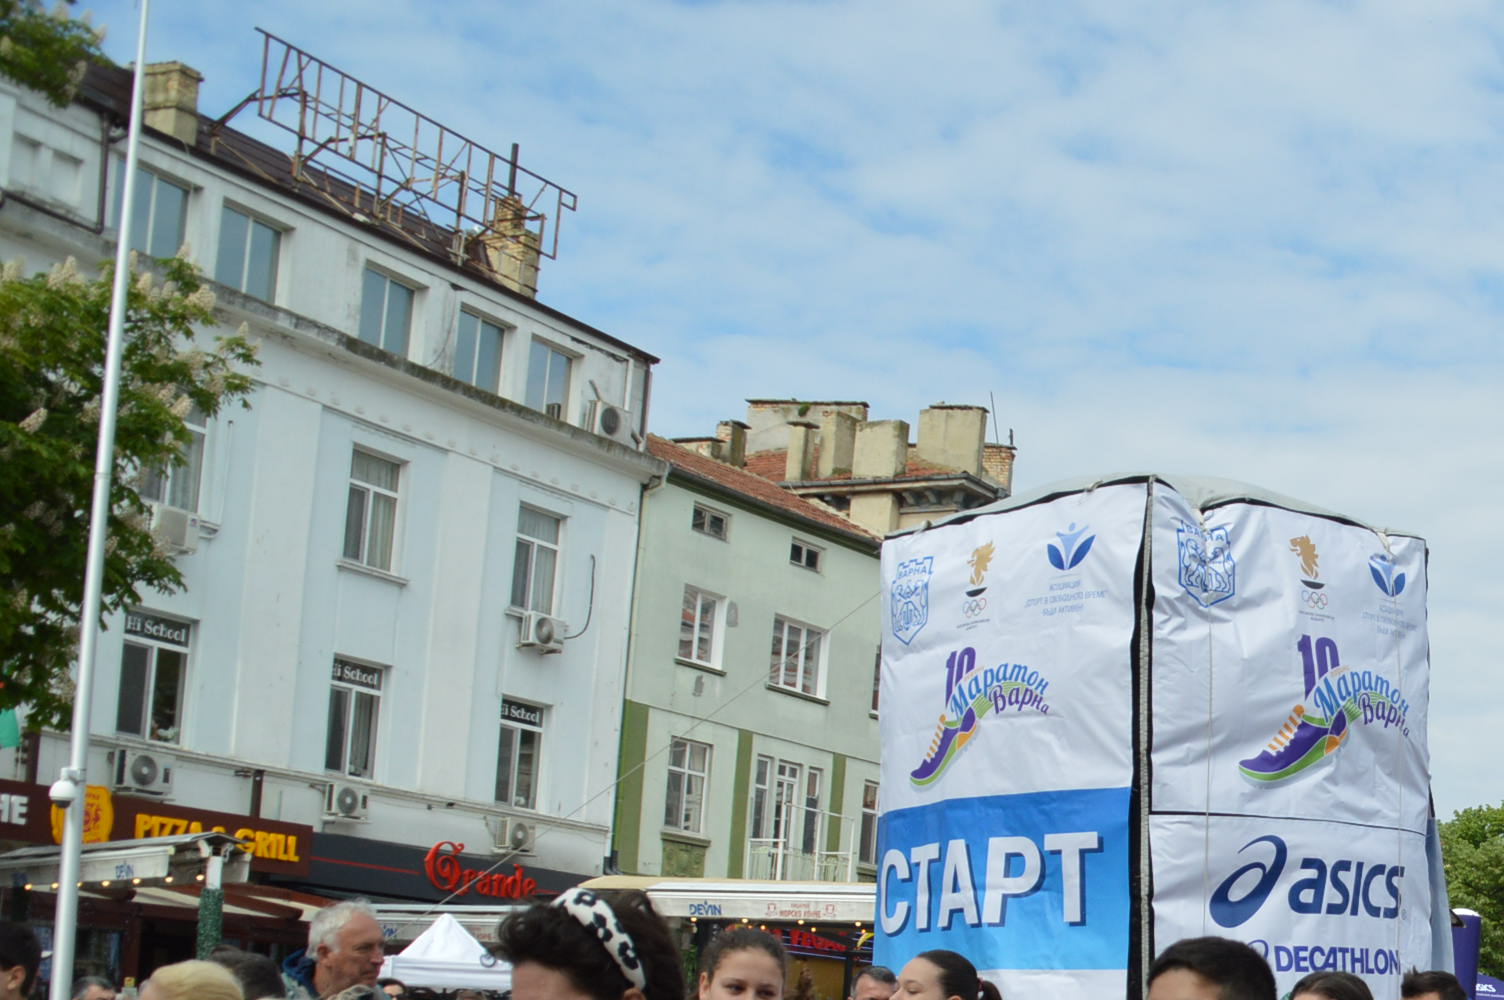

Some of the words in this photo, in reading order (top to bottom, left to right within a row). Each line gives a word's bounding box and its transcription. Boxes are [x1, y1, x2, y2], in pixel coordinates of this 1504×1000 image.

[144, 620, 186, 642] School
[343, 666, 377, 686] School
[989, 684, 1050, 715] Варна
[510, 706, 540, 724] School
[234, 828, 300, 862] GRILL
[424, 841, 537, 899] Grande
[879, 831, 1101, 936] СТАРТ
[689, 900, 722, 916] DEVIN
[1274, 945, 1401, 975] DECATHLON
